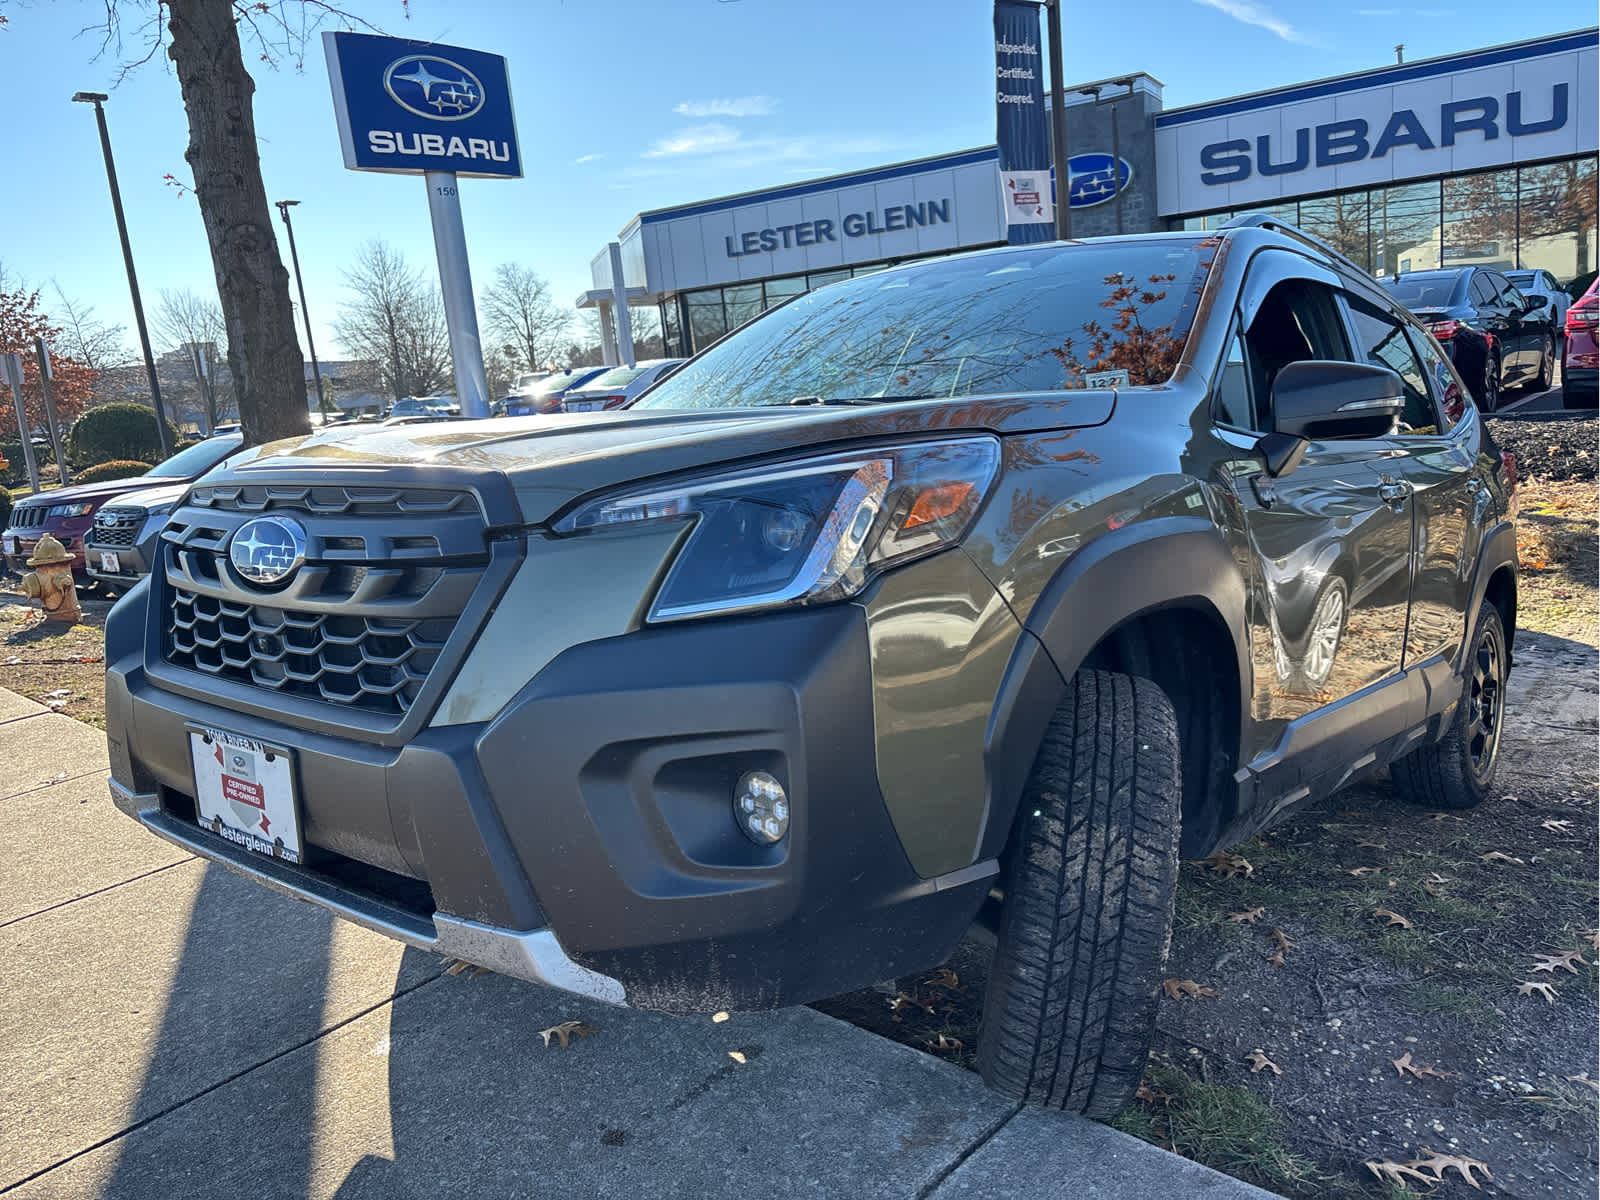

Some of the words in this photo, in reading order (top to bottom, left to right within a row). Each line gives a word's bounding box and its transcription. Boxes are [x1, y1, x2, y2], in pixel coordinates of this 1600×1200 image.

[996, 66, 1035, 79] Certified.
[996, 91, 1034, 104] Covered.
[368, 130, 510, 162] SUBARU
[1200, 83, 1568, 185] SUBARU
[725, 219, 836, 258] LESTER
[842, 198, 950, 238] GLENN
[226, 787, 261, 805] PRE-OWNED
[228, 779, 257, 795] CERTIFIED
[219, 823, 274, 857] lesterglenn
